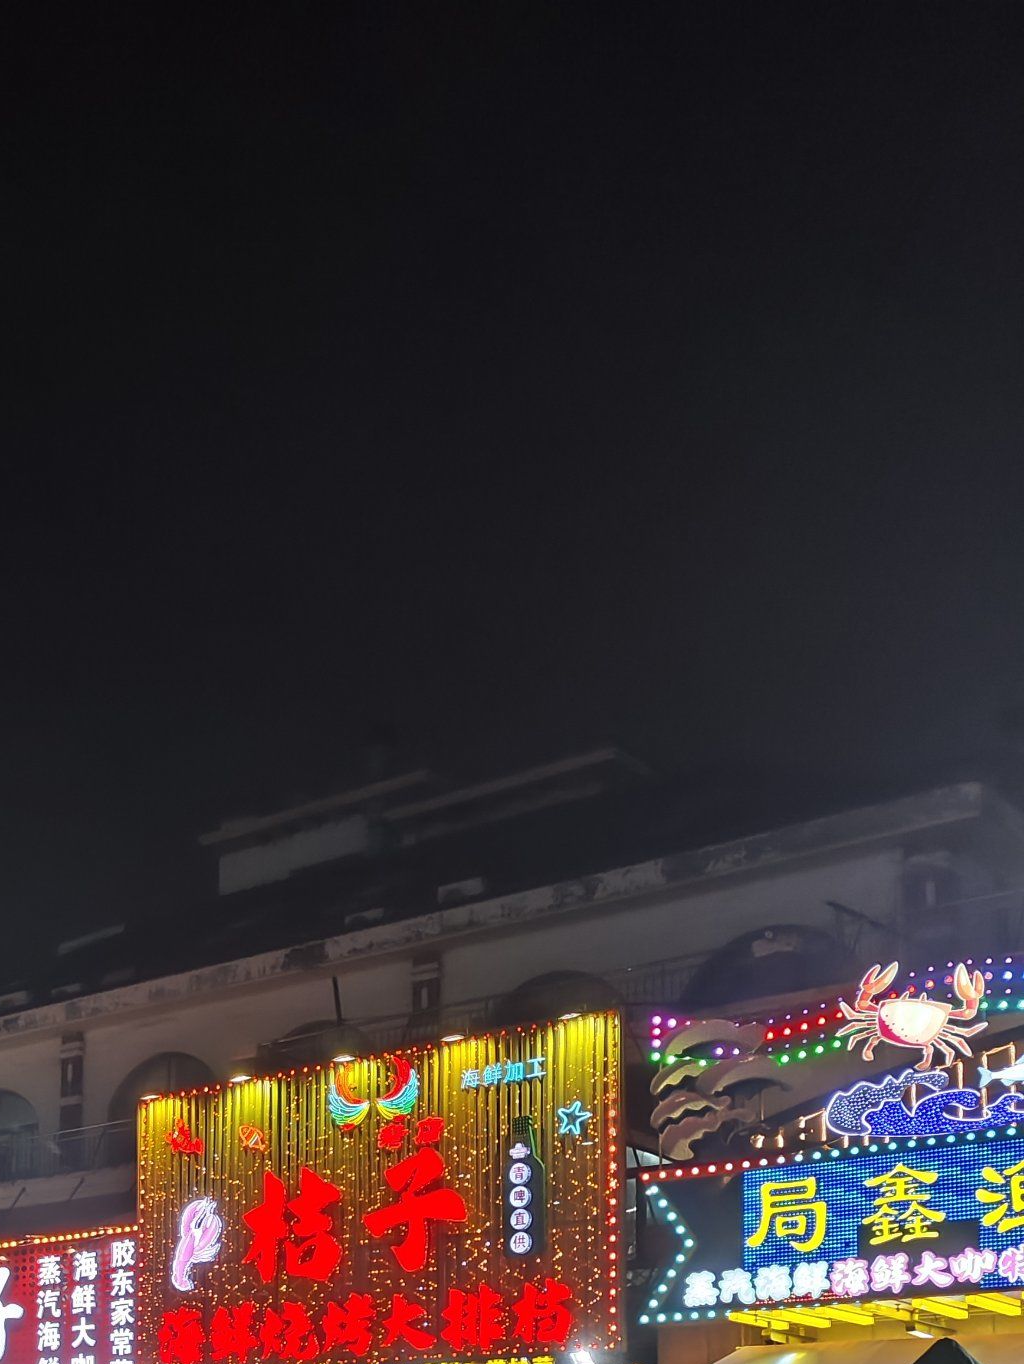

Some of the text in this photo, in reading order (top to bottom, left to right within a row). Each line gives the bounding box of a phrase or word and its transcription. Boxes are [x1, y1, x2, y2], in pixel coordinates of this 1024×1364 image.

[461, 1057, 547, 1089] 海鲜加工
[242, 1147, 466, 1283] 桔子
[511, 1165, 529, 1251] 青啤直供
[684, 1260, 830, 1308] 蒸汽海鲜
[830, 1247, 998, 1297] 海鲜大咖
